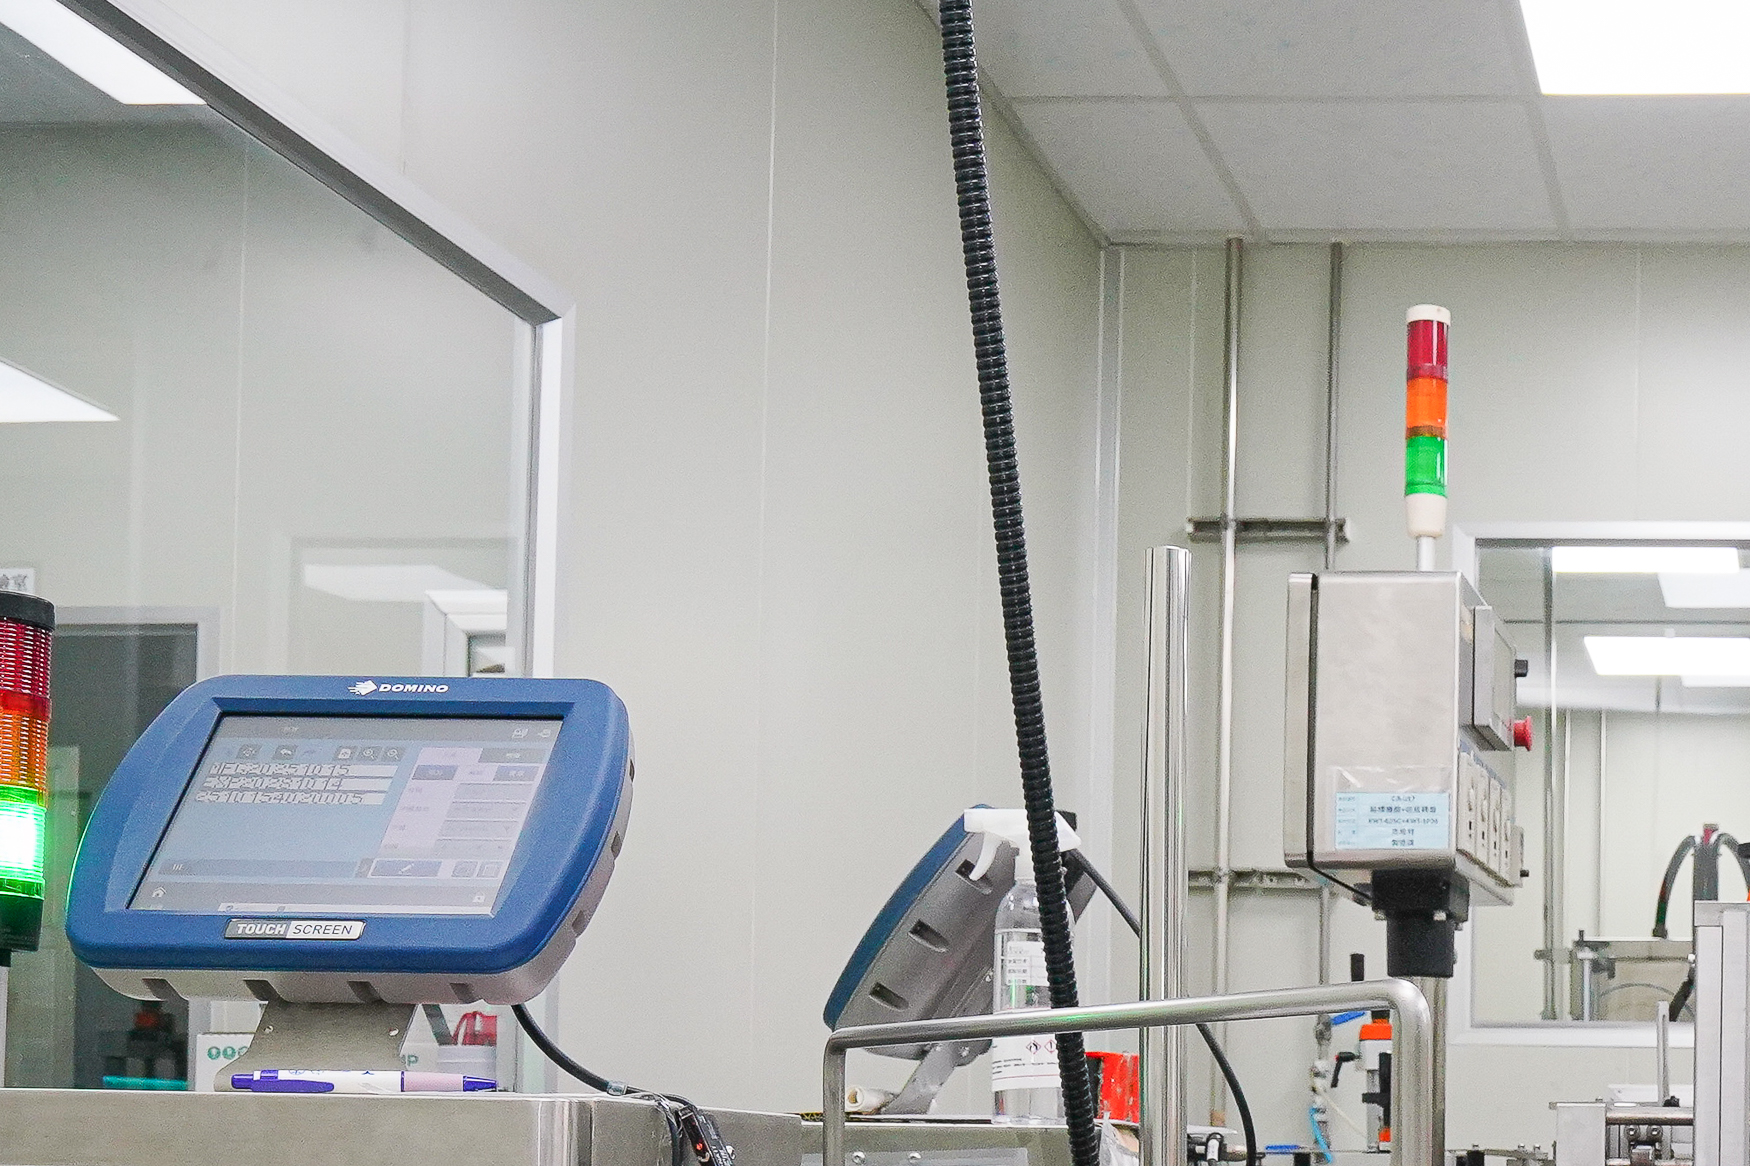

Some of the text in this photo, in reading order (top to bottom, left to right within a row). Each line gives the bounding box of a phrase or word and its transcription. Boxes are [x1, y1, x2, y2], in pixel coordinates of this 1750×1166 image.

[379, 683, 449, 693] DOMINO
[237, 923, 353, 935] TOUCH SCREEN
